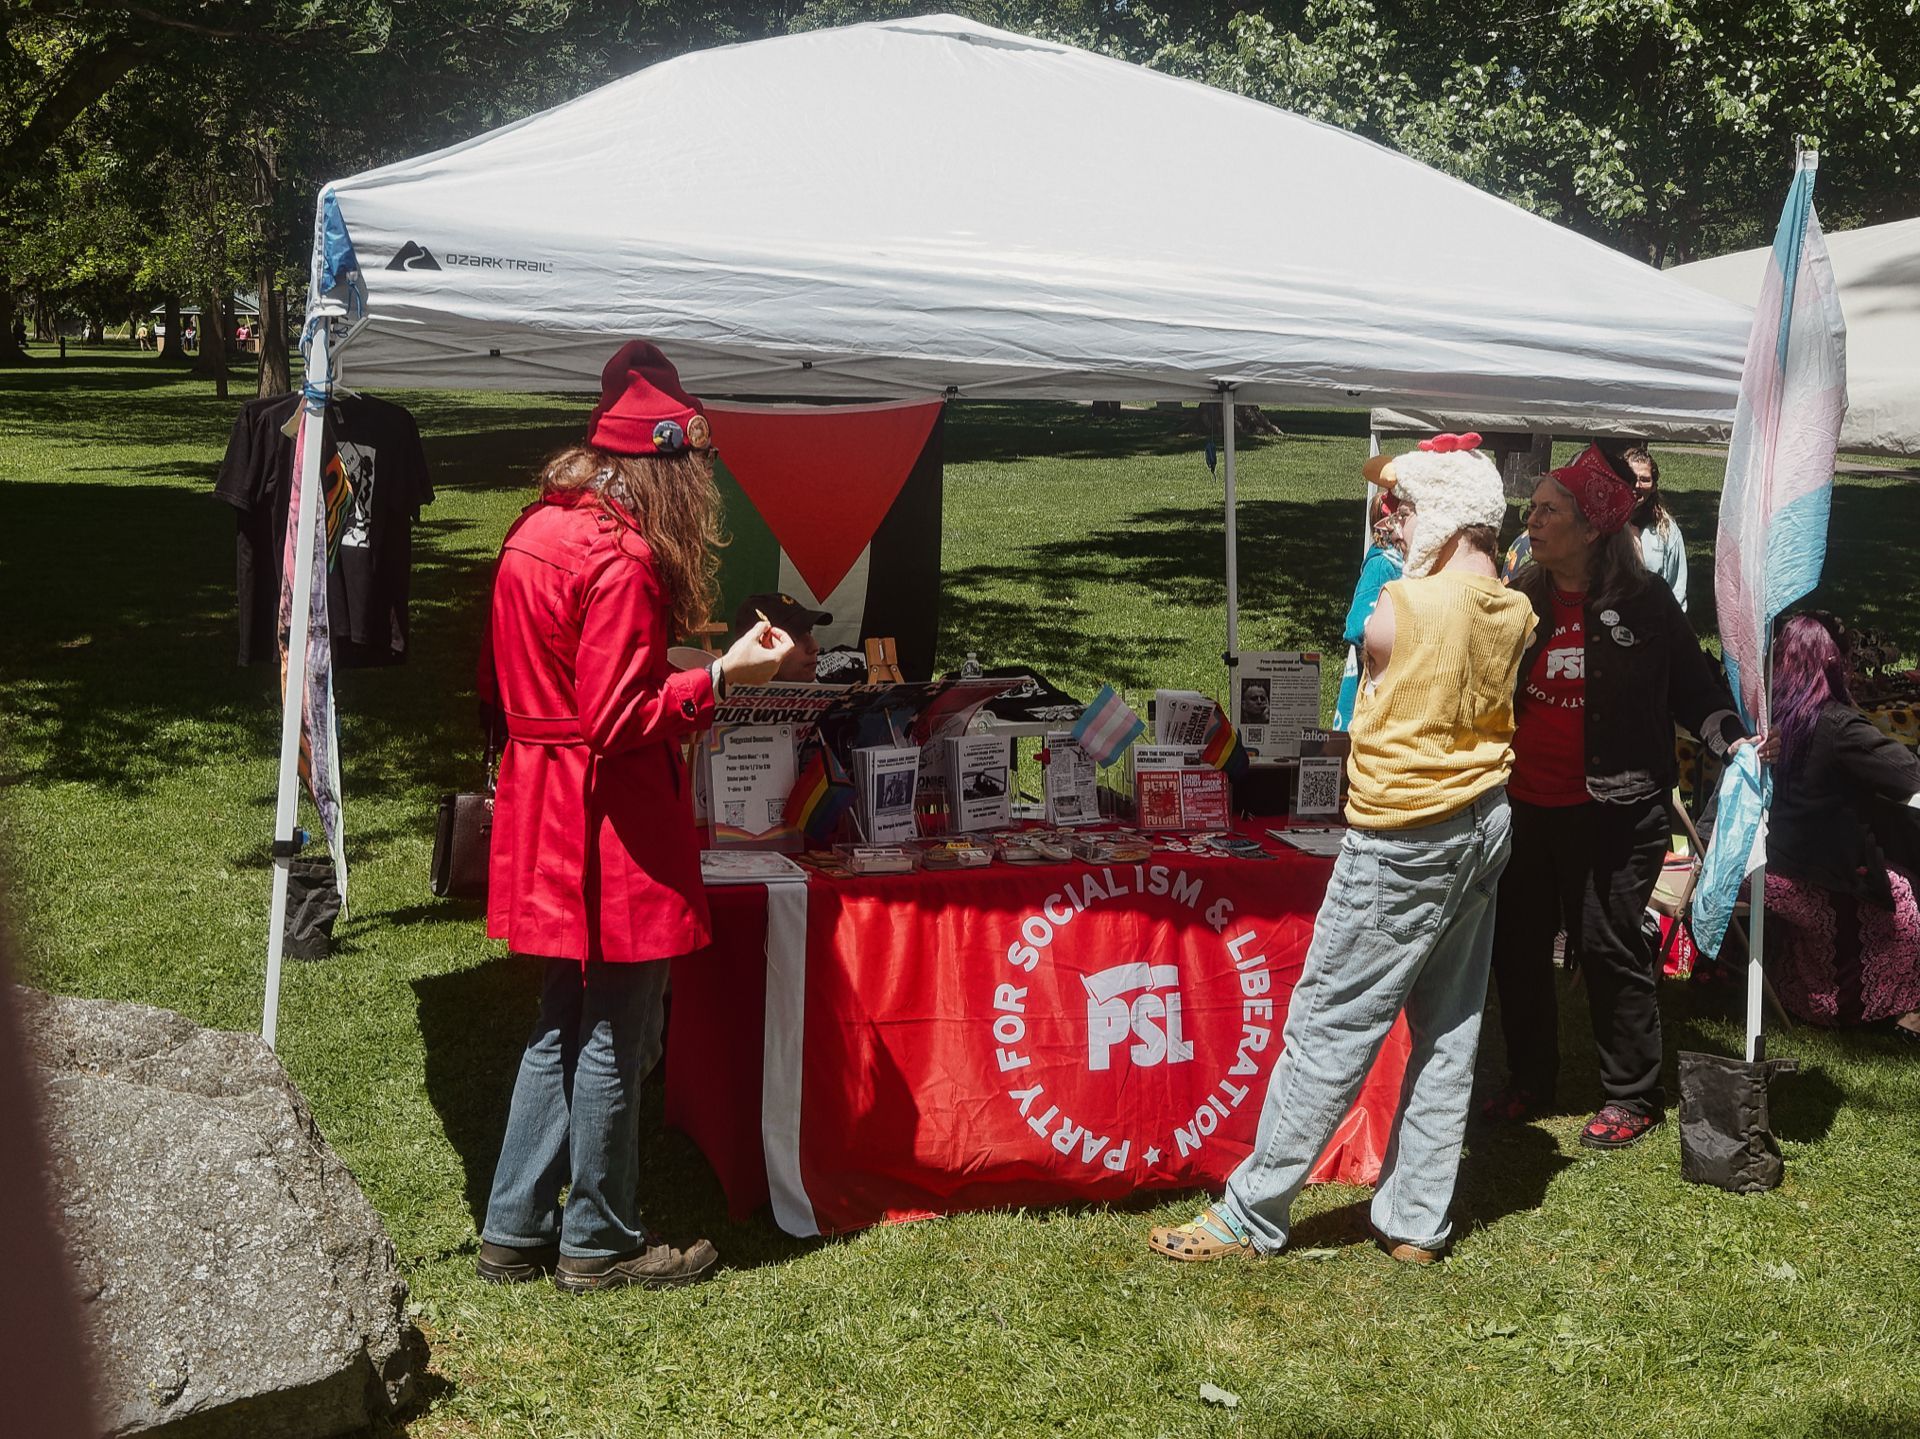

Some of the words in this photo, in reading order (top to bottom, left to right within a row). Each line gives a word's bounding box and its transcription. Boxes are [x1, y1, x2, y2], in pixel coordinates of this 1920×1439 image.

[446, 253, 503, 269] OZARK
[722, 697, 833, 709] DESTROYING
[731, 687, 764, 697] THE
[765, 687, 809, 698] RICH
[808, 689, 846, 699] ARE
[1526, 683, 1556, 705] FOR
[1561, 697, 1585, 709] RTY
[712, 708, 753, 722] OUR
[752, 708, 824, 724] WORLD
[1183, 711, 1201, 745] OCIALISM
[1192, 706, 1213, 745] BERATION
[1146, 815, 1181, 825] FUTURE
[1007, 865, 1203, 972] SOCIALISM
[1205, 898, 1234, 933] &
[993, 982, 1031, 1073] FOR
[1087, 992, 1194, 1071] PSL
[1174, 930, 1273, 1158] LIBERATION
[1008, 1083, 1131, 1172] PARTY
